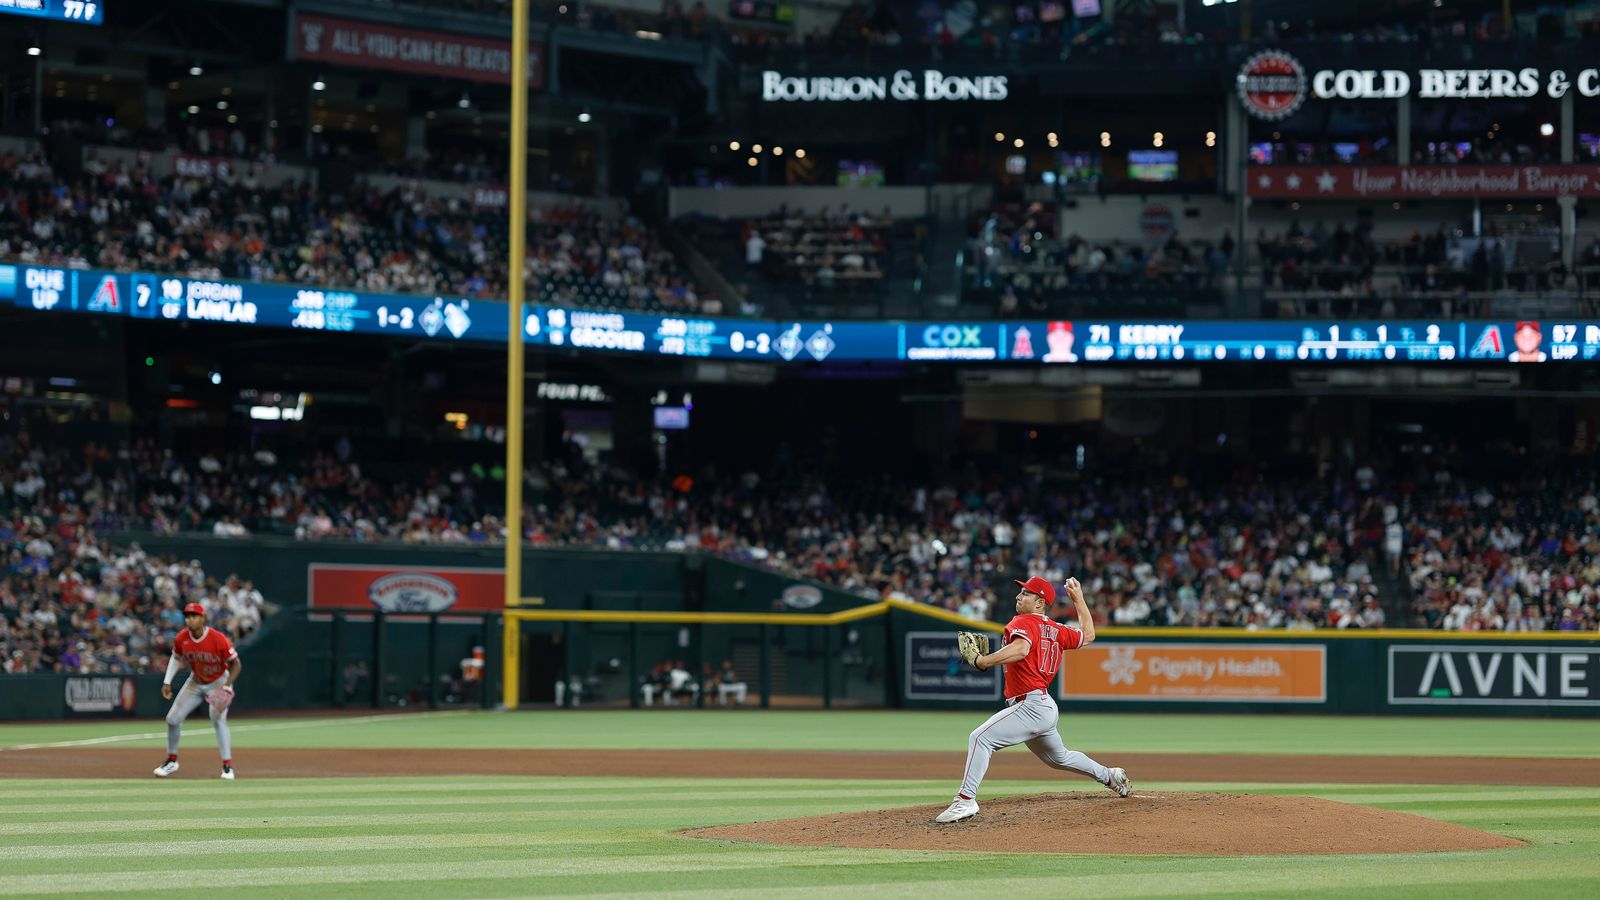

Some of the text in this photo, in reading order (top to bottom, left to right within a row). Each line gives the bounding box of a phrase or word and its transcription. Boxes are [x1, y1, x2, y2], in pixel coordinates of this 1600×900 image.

[762, 69, 1008, 101] BOURBON & BONES
[1313, 69, 1411, 99] COLD
[1419, 68, 1540, 99] BEERS
[1547, 70, 1571, 99] &
[1353, 167, 1396, 196] Your
[1401, 168, 1520, 195] Neighborhood
[1522, 166, 1588, 194] Burger
[25, 268, 65, 291] DUE
[32, 289, 59, 310] UP
[923, 324, 982, 348] COX
[1089, 325, 1184, 345] 71 KERRY
[1585, 325, 1600, 345] R
[537, 382, 580, 400] FOUR
[1039, 640, 1059, 674] 71
[1149, 656, 1217, 681] Dignity
